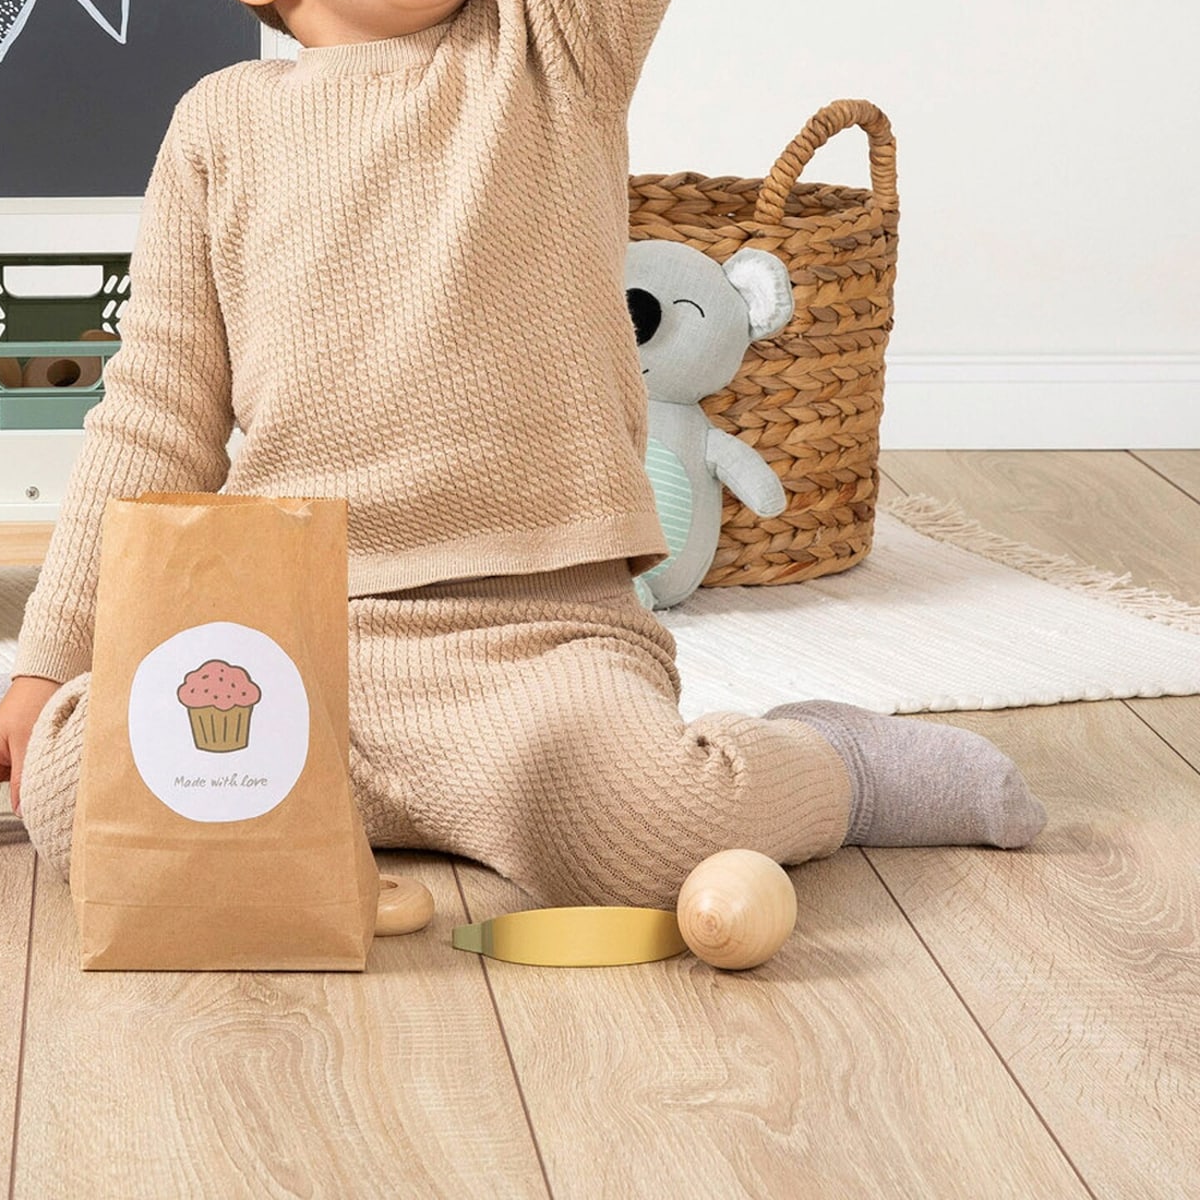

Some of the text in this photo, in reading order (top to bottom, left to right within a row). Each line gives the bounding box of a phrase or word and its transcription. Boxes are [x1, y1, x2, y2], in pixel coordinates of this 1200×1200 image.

[174, 773, 268, 788] Made with love
